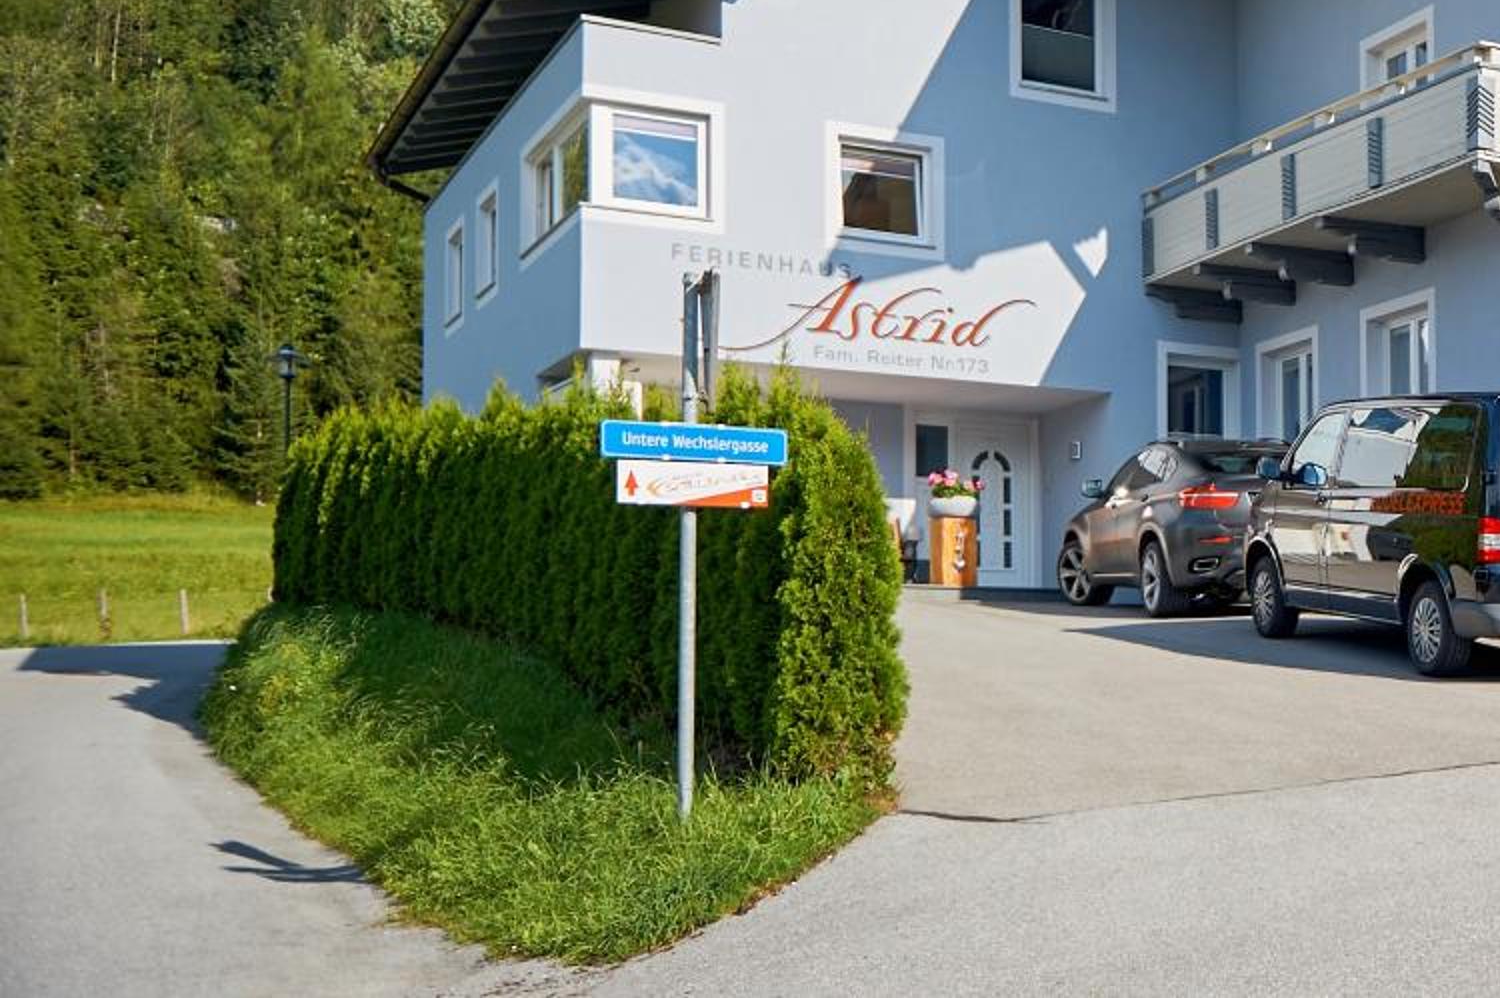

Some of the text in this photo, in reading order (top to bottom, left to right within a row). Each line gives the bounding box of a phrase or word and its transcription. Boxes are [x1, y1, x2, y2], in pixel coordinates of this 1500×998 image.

[671, 243, 850, 279] FERIENHAUS
[718, 275, 1036, 350] Astrid
[813, 345, 858, 363] Fam.
[867, 349, 922, 368] Reiter
[621, 431, 769, 455] Untere Wechslergasse
